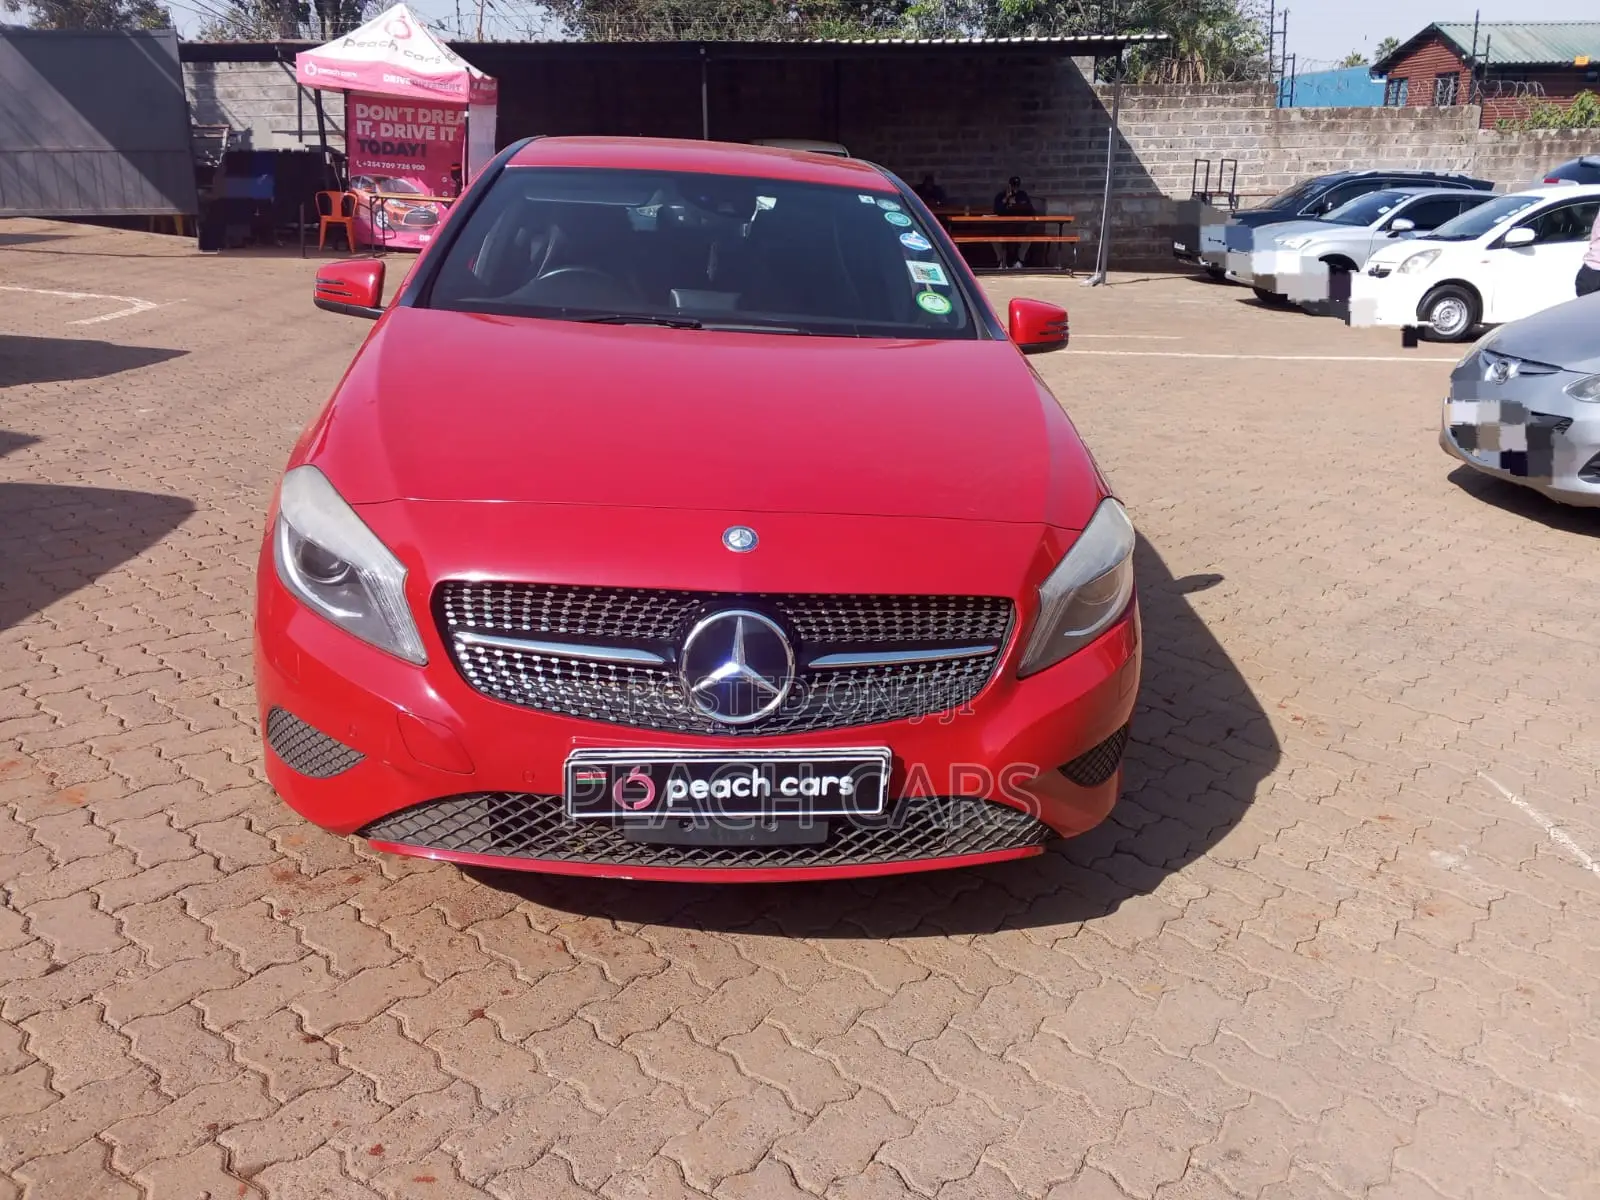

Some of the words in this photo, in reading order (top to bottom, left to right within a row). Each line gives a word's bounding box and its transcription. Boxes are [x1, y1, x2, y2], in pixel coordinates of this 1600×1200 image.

[343, 38, 398, 51] peach
[403, 49, 441, 64] cars
[356, 103, 415, 122] DON'T
[356, 120, 376, 138] IT,
[380, 123, 436, 140] DRIVE
[440, 127, 456, 141] IT
[358, 139, 427, 157] TODAY!
[667, 768, 770, 807] peach
[780, 775, 854, 796] cars
